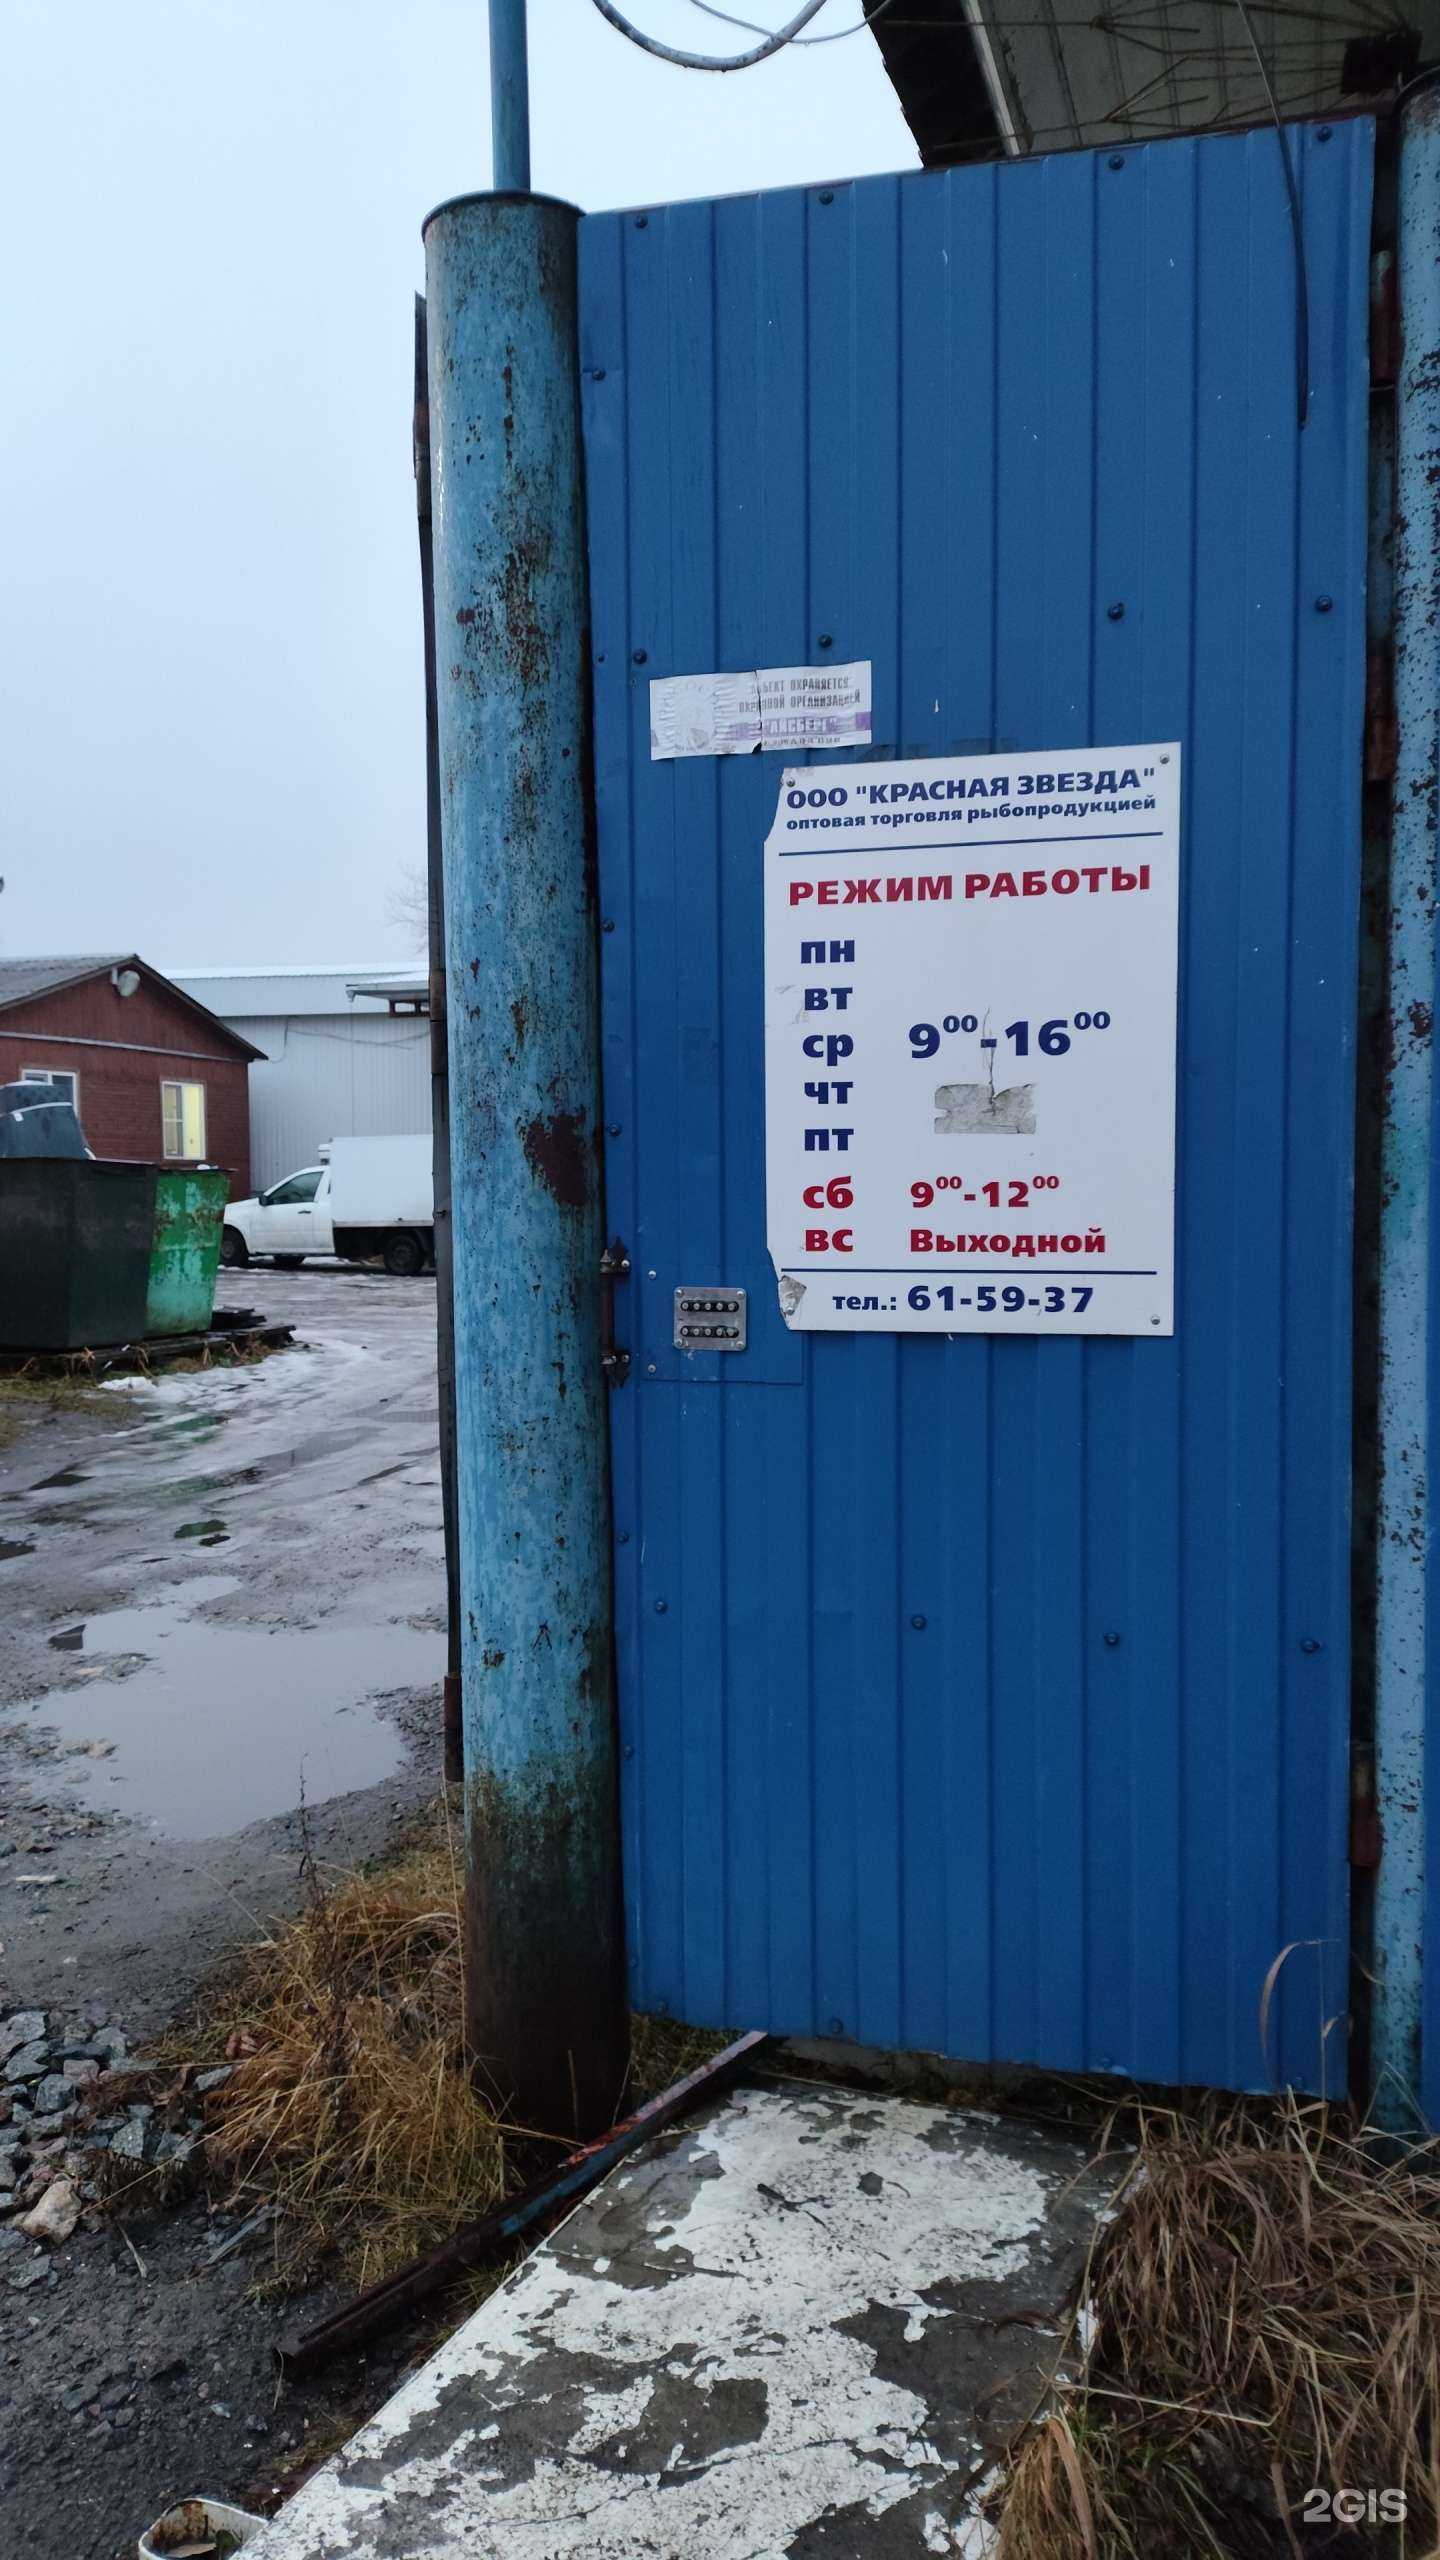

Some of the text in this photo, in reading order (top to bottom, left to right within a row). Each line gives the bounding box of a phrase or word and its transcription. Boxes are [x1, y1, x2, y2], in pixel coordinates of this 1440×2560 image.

[790, 676, 849, 691] ОХРАНЯЕТСЯ
[786, 767, 1156, 809] ООО "КРАСНАЯ ЗВЕЗДА"
[786, 794, 1157, 831] оптовая торговля рыбопродукцией
[789, 865, 1151, 906] РЕЖИМ РАБОТЫ
[800, 940, 856, 964] пн
[804, 987, 854, 1011] вт
[802, 1033, 854, 1066] ср
[804, 1081, 854, 1105] чт
[804, 1128, 854, 1151] пт
[802, 1175, 854, 1209] сб
[804, 1227, 1106, 1258] вс Выходной
[832, 1285, 1095, 1313] тел.: 61-59-37
